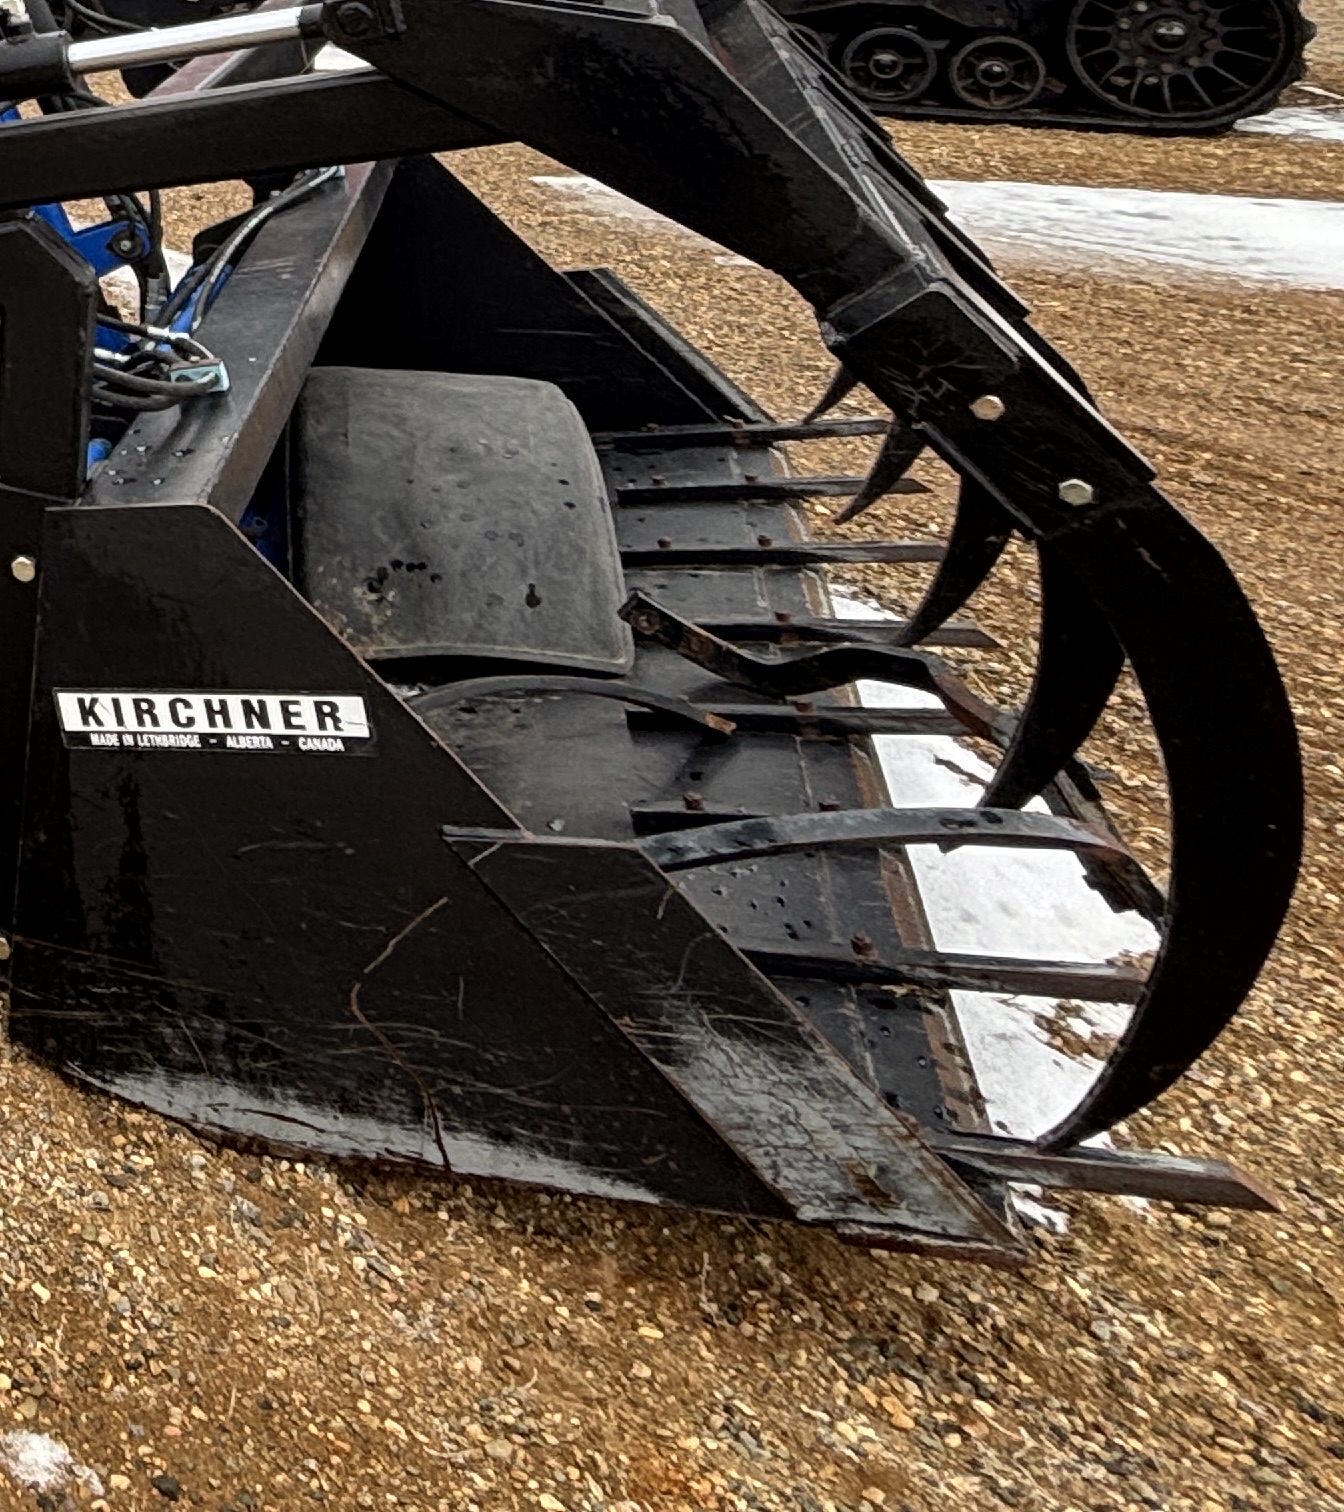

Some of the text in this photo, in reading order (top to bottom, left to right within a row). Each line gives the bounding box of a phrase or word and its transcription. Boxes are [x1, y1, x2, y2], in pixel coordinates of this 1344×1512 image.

[76, 695, 346, 732] KIRCHNER
[89, 733, 120, 747] MADE
[122, 734, 135, 747] IN
[226, 734, 275, 750] ALBERTA
[298, 736, 346, 752] CANADA
